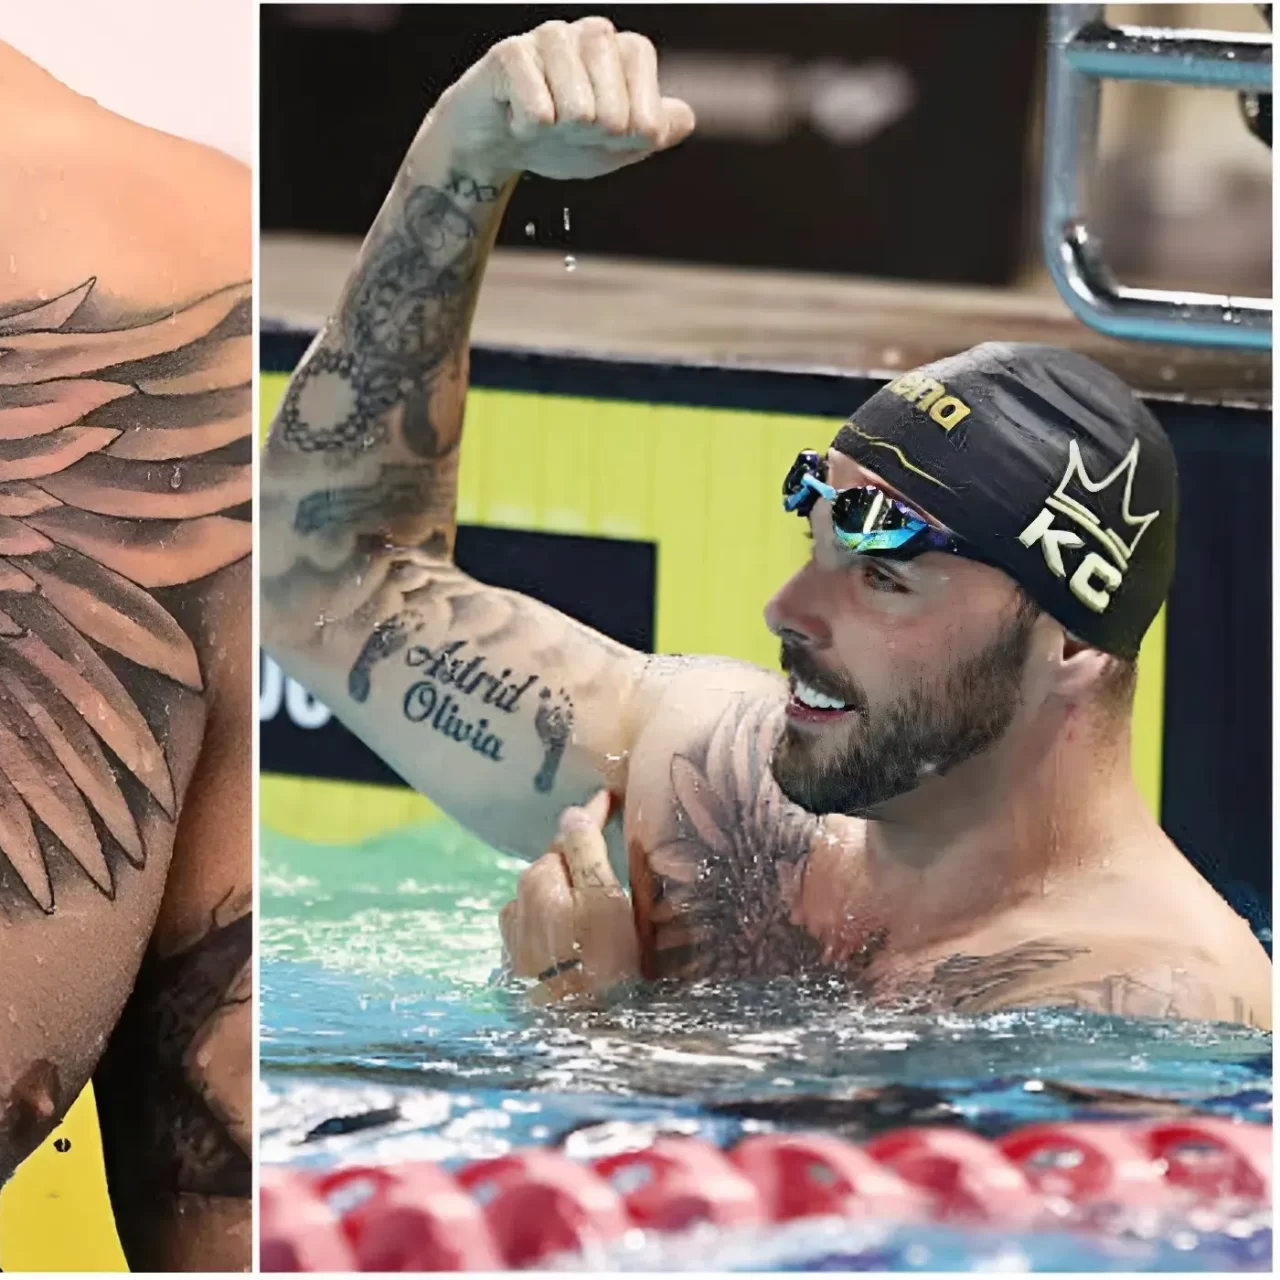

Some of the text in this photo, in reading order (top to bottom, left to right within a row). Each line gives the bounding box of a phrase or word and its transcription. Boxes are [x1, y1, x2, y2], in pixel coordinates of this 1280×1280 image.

[1020, 507, 1122, 613] KC
[405, 640, 540, 713] Astrid
[404, 680, 504, 761] Olivia
